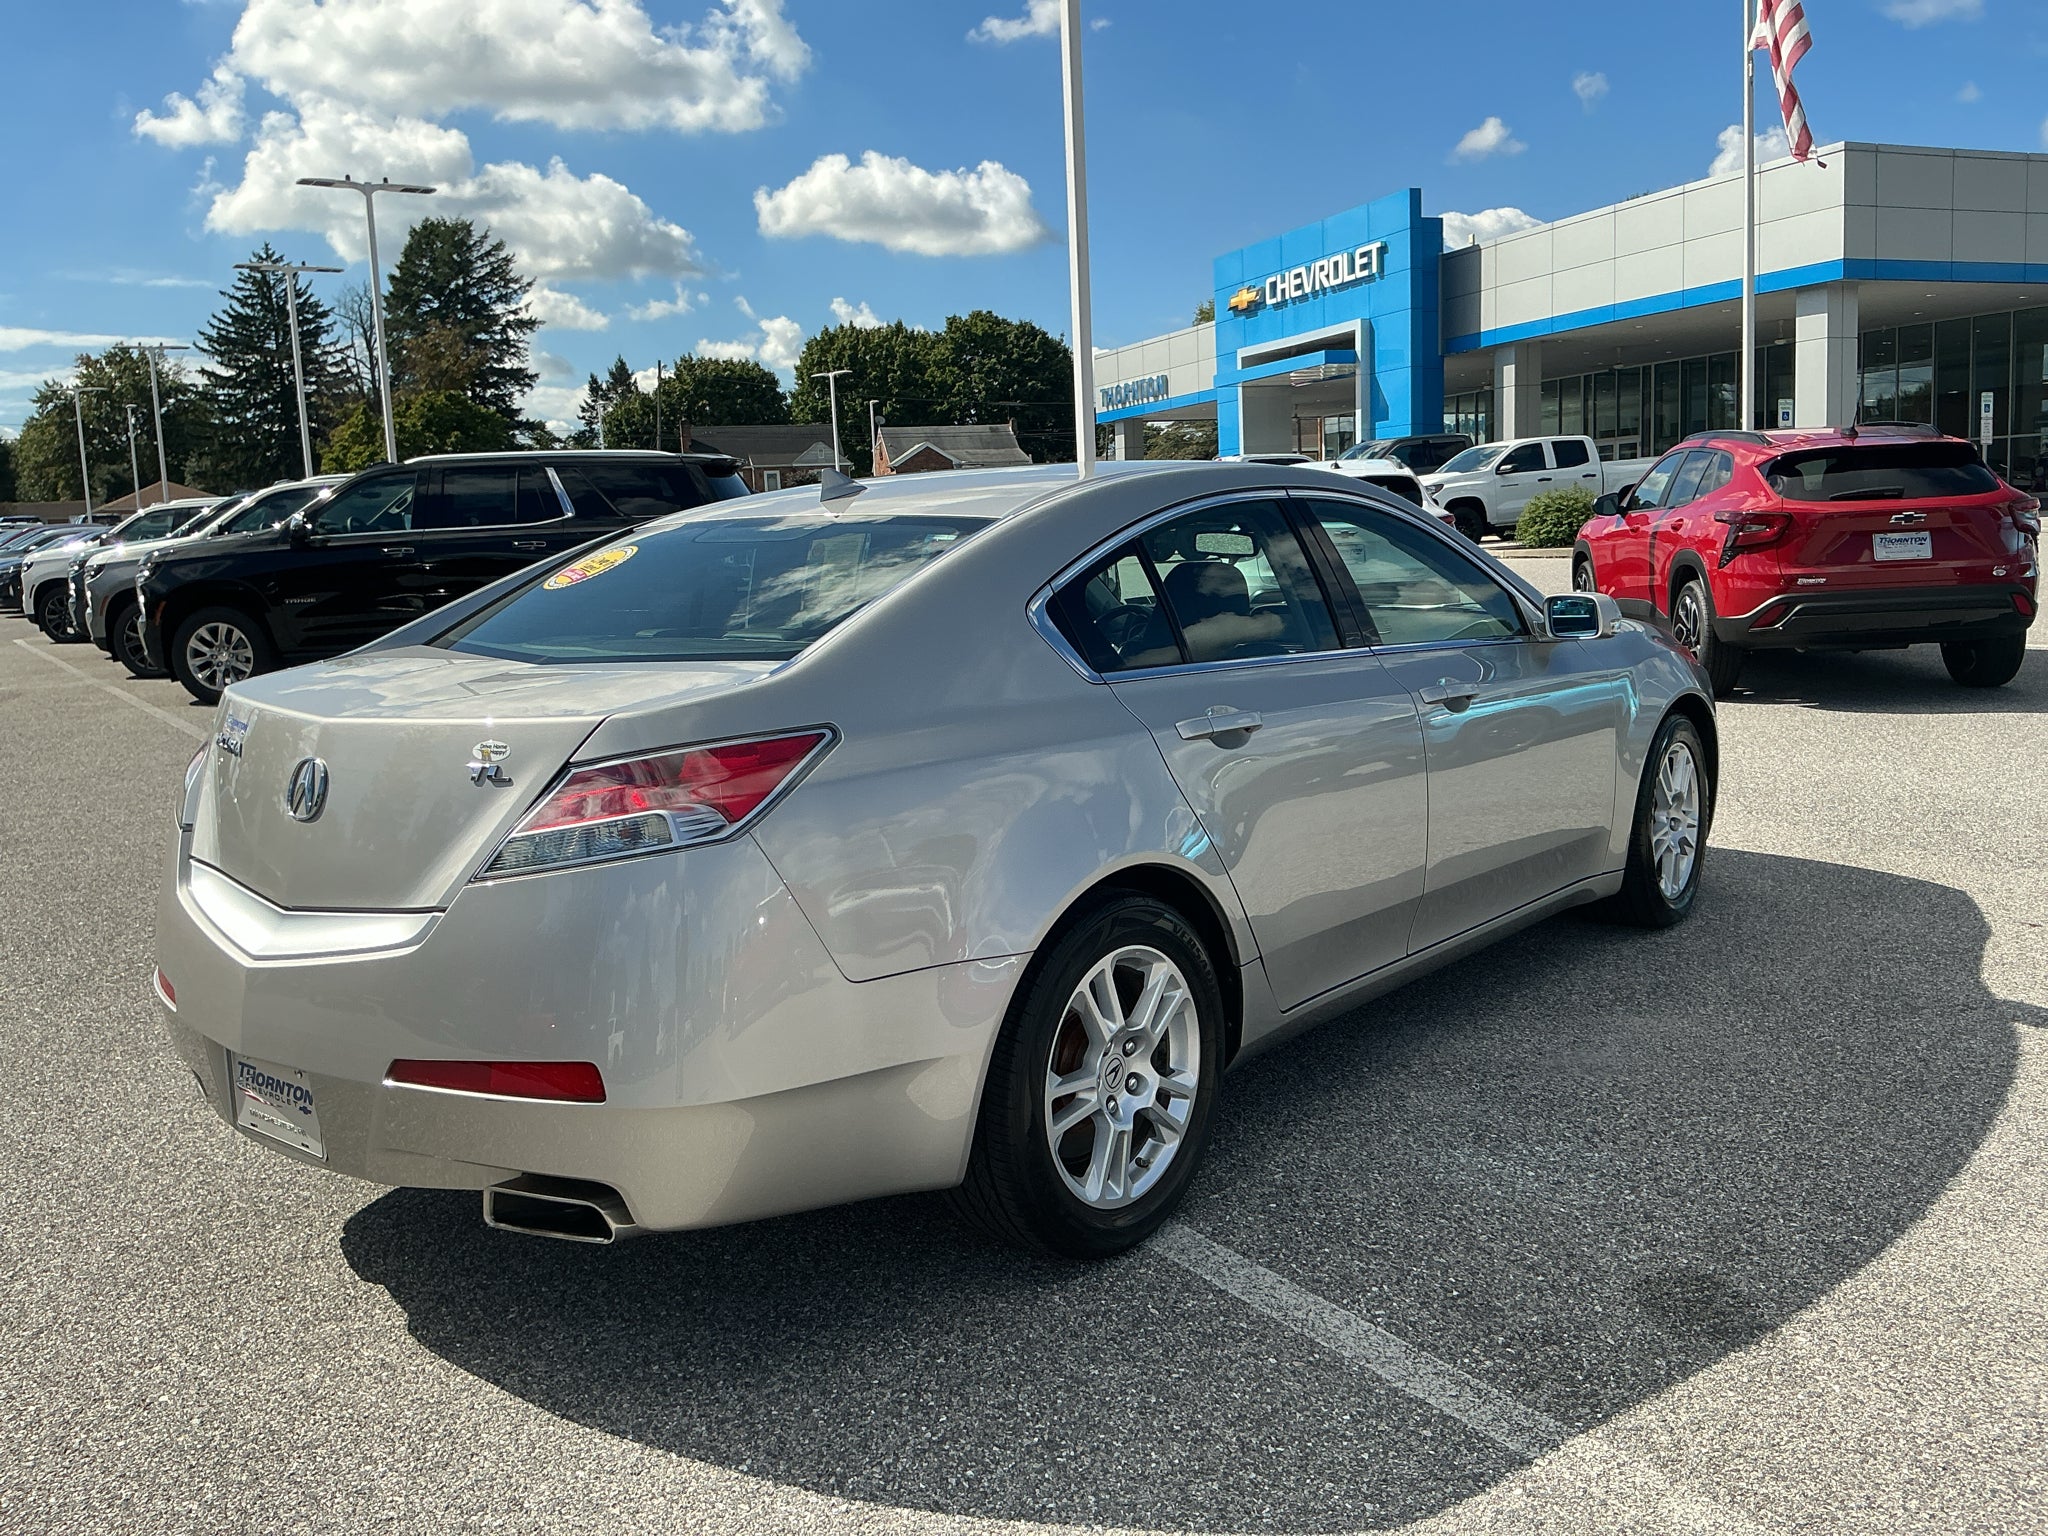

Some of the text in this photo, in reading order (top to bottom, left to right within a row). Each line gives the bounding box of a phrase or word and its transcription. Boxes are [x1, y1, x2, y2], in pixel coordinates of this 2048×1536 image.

[1265, 241, 1386, 305] CHEVROLET
[1099, 374, 1169, 411] THORNTON
[1879, 536, 1928, 544] THORNTON
[238, 1061, 314, 1106] THORNTON
[245, 1081, 298, 1108] CHEVROLET
